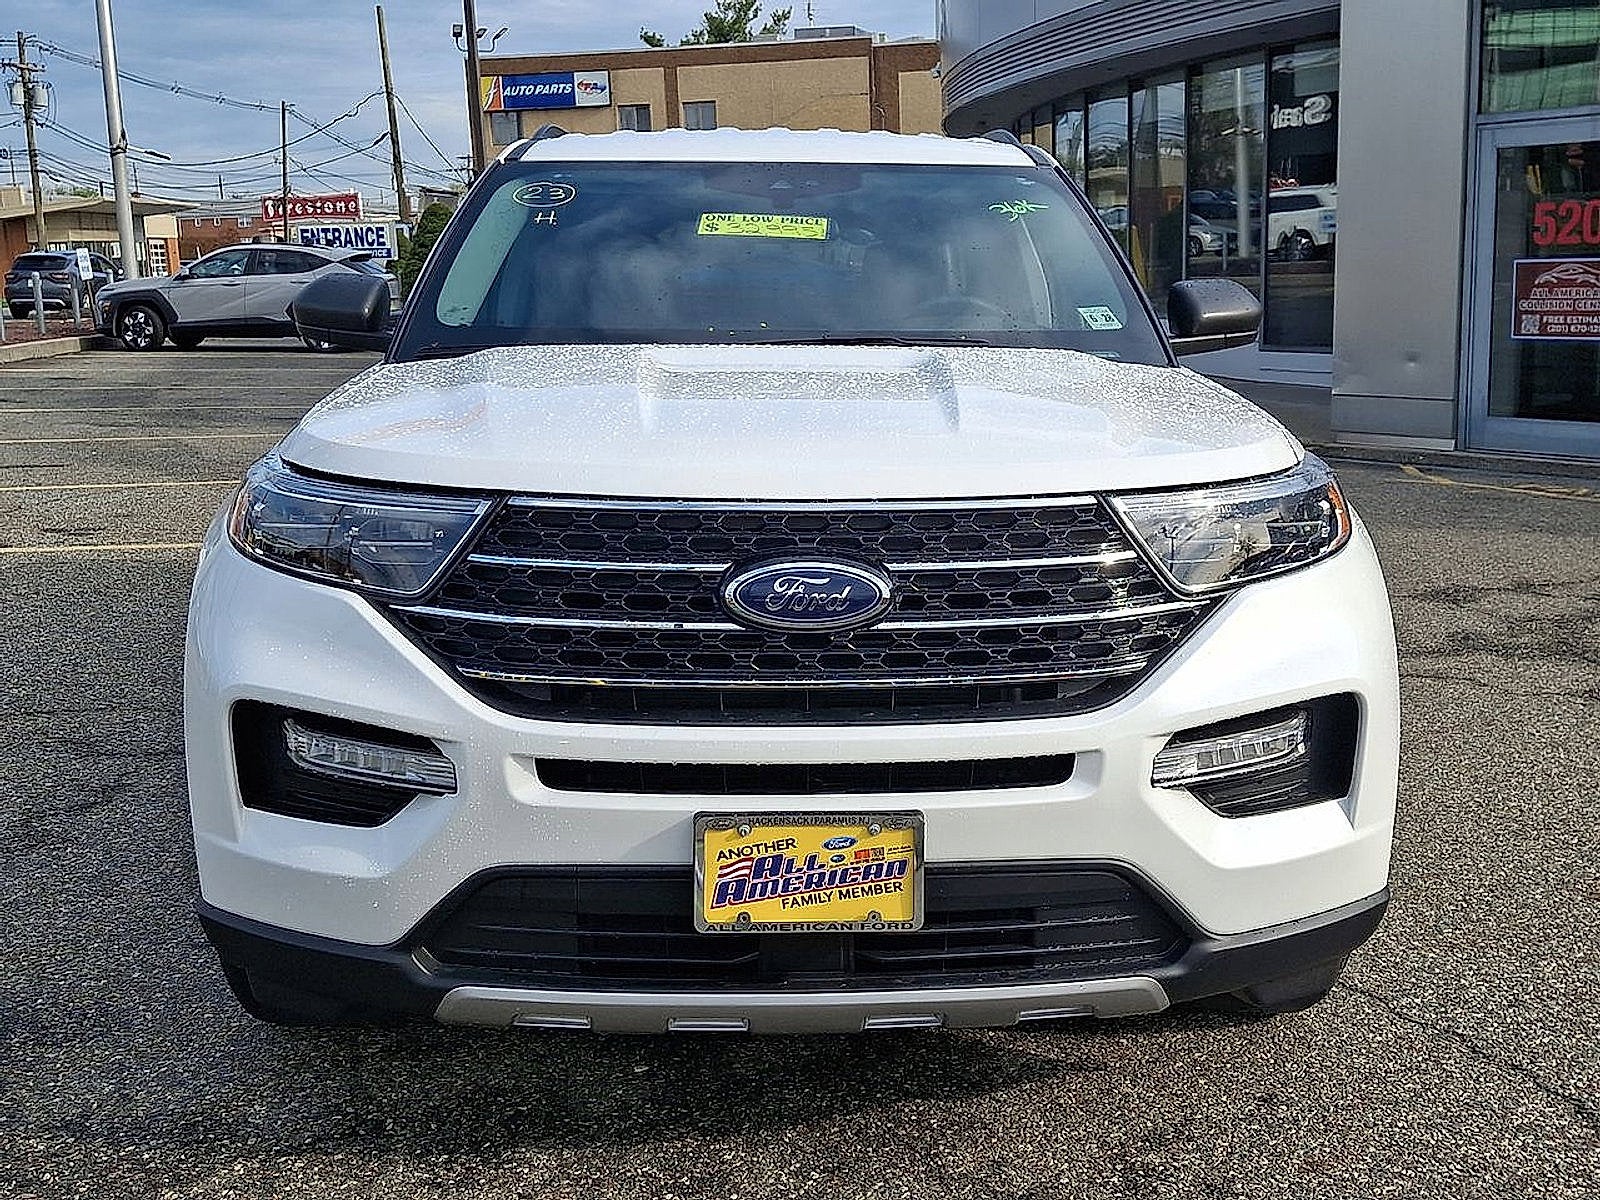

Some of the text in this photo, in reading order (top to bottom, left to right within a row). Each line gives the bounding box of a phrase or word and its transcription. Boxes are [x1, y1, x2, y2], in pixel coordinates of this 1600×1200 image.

[503, 85, 534, 97] AUTO
[535, 83, 573, 95] PARTS
[522, 186, 566, 200] 23
[264, 199, 358, 218] Firestone
[705, 214, 824, 225] ONE LOW PRICE
[1532, 200, 1600, 246] 520
[299, 226, 387, 247] ENTRANCE
[765, 575, 852, 612] Ford
[716, 837, 797, 862] ANOTHER
[827, 837, 854, 849] Ford
[750, 853, 827, 881] ALL
[713, 858, 908, 906] AMERICAN
[781, 881, 904, 910] FAMILY MEMBER
[704, 922, 914, 932] ALL AMERICAN FORD
